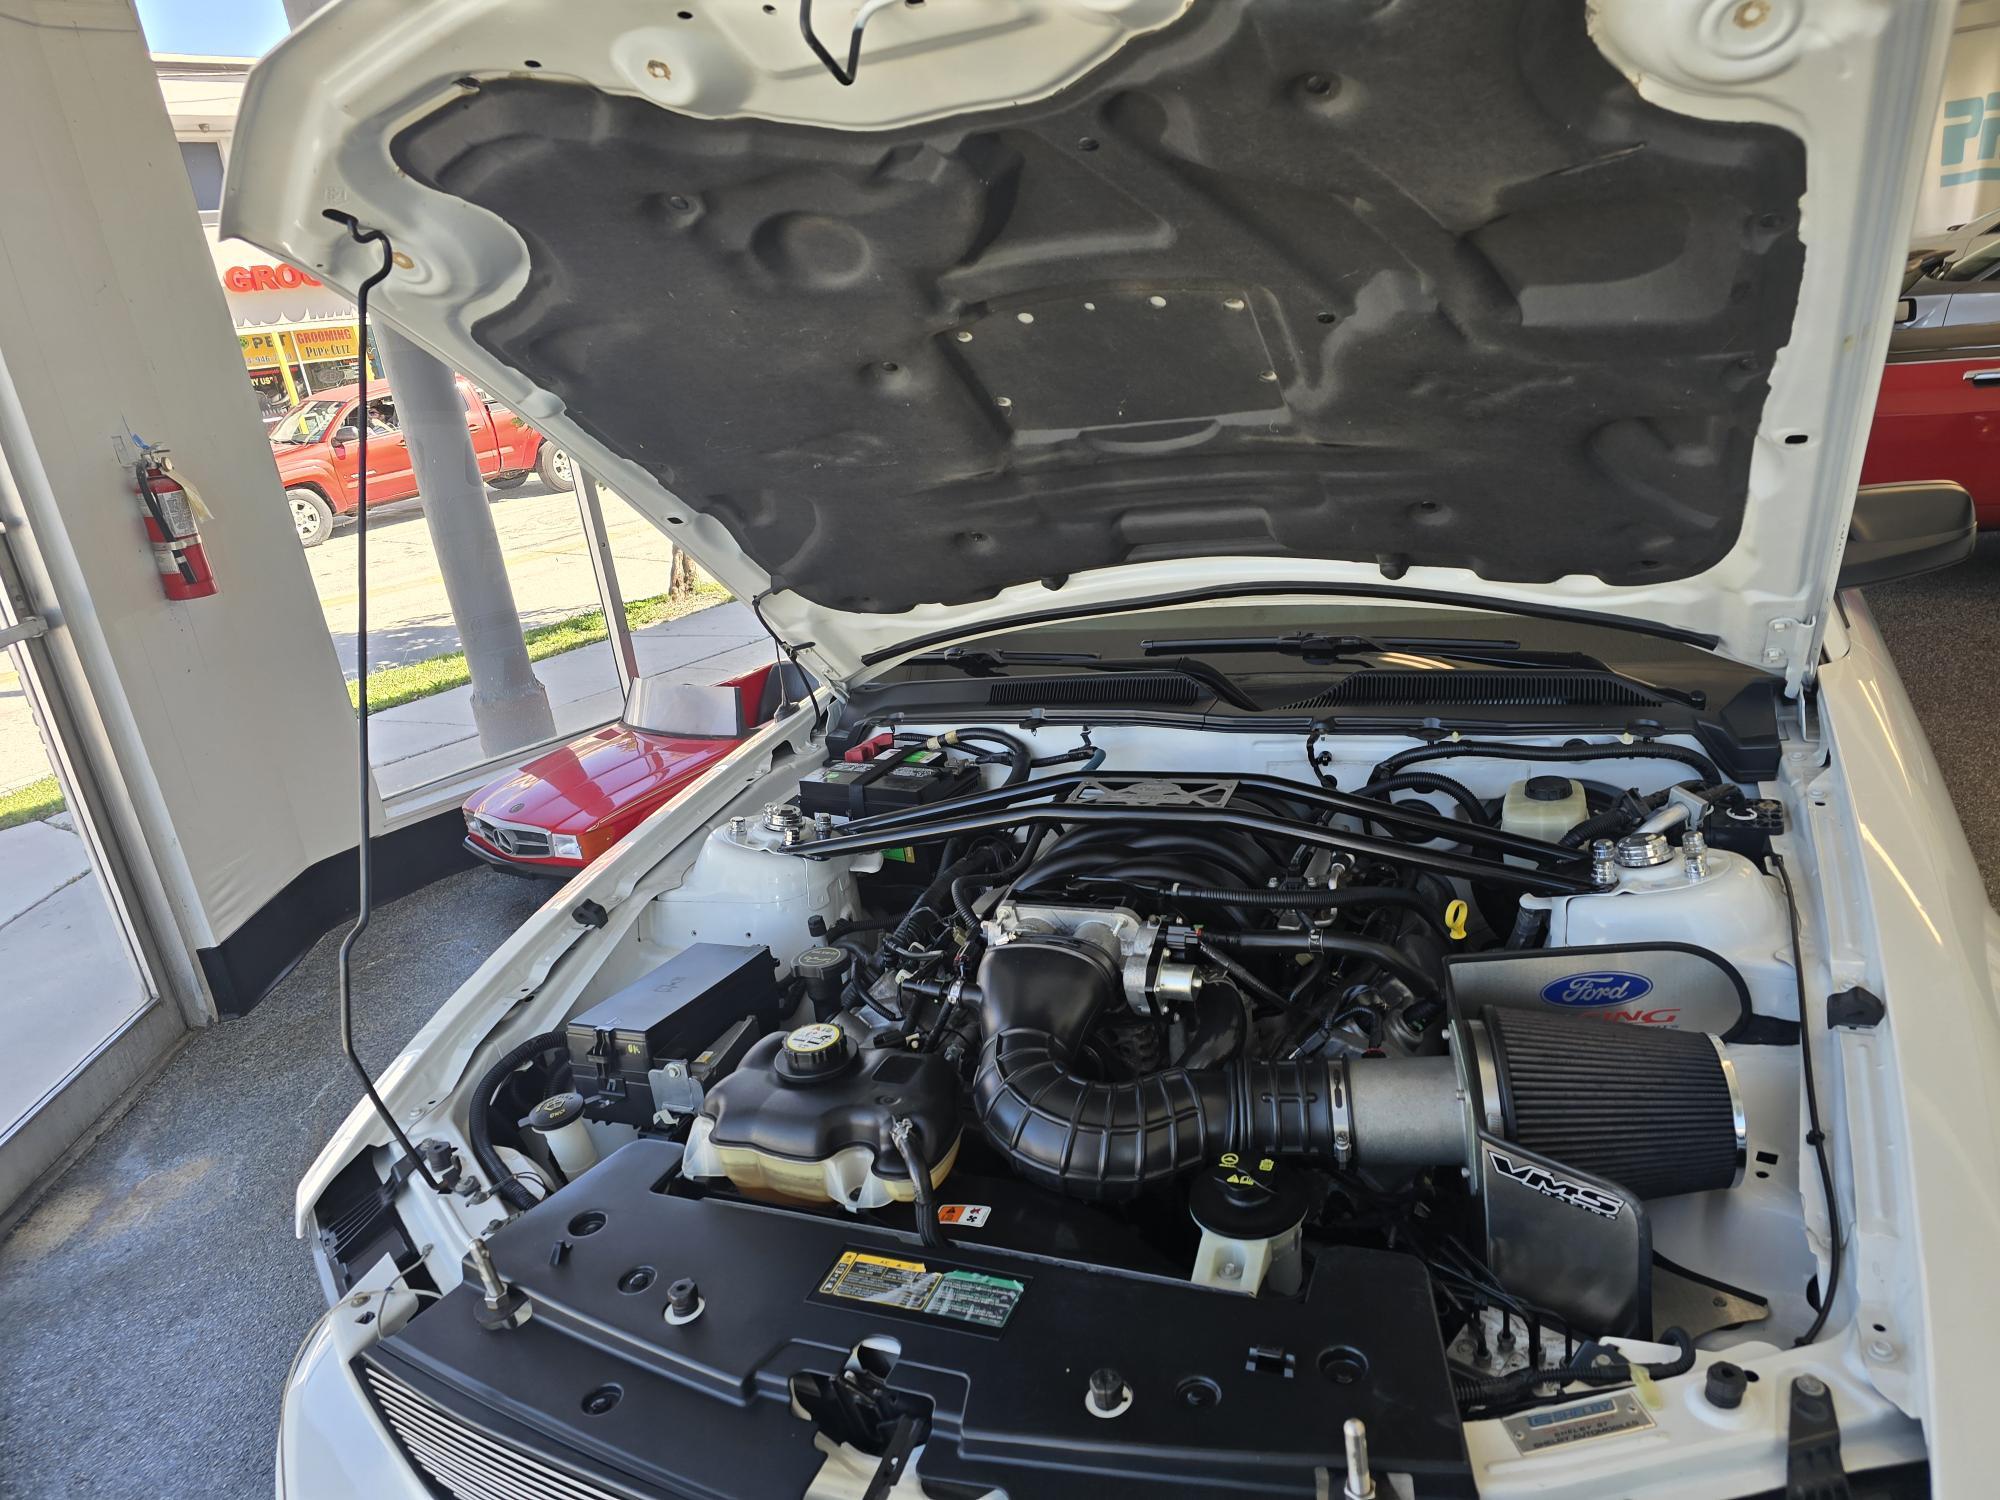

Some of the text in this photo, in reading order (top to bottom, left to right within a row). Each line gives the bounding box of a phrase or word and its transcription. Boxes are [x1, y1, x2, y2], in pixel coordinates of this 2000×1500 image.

[296, 328, 352, 344] GROOMING
[1562, 977, 1630, 1002] Ford
[1488, 1150, 1626, 1215] VMS
